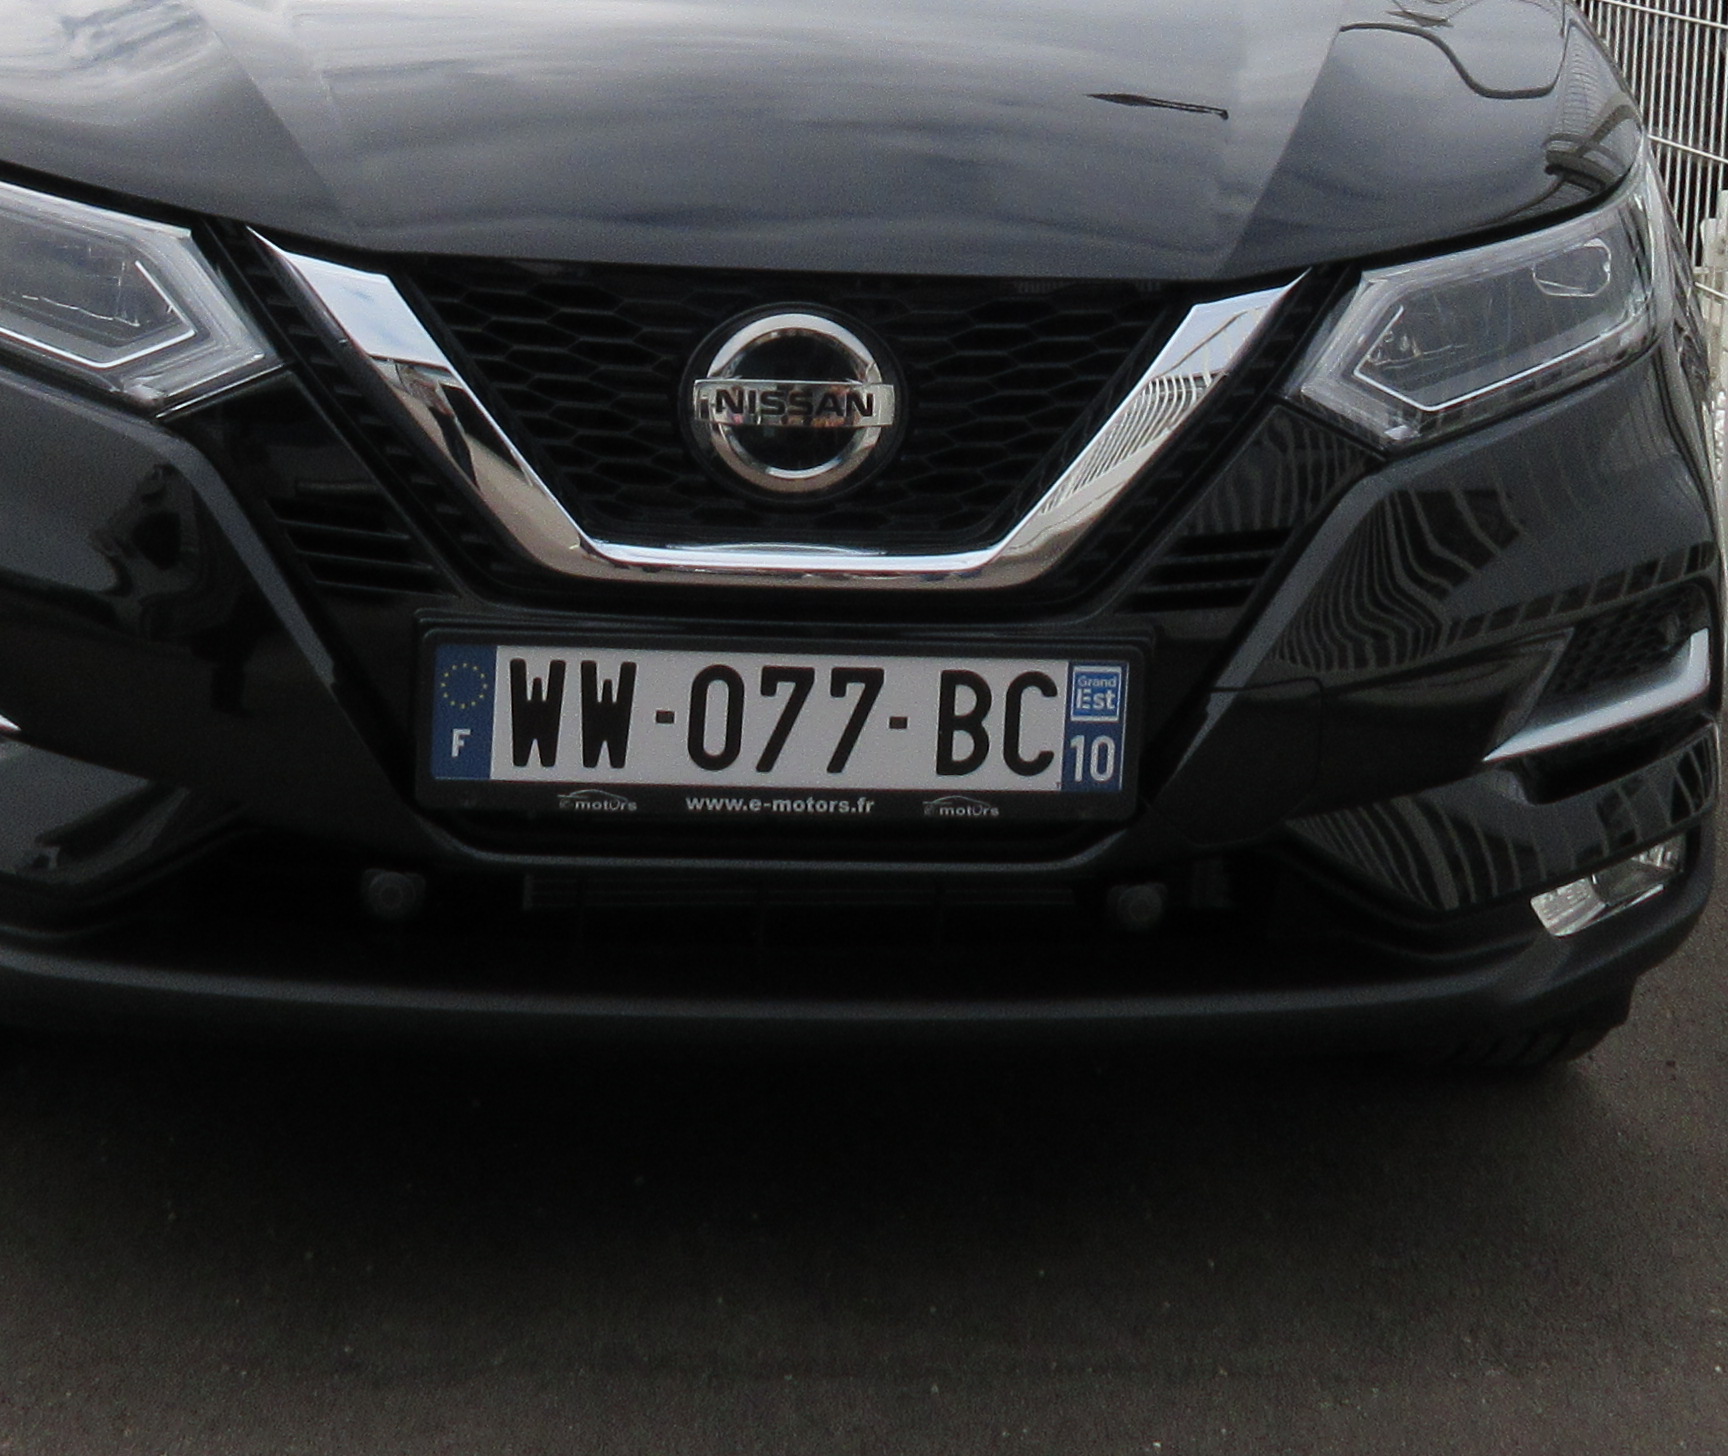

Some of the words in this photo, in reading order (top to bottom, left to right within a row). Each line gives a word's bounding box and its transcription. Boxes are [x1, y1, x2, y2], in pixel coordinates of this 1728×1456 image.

[715, 388, 874, 417] NISSAN
[1077, 675, 1117, 688] Grand
[1076, 688, 1116, 710] Est
[509, 658, 1059, 777] WW-077-BC
[451, 728, 471, 758] F
[1070, 735, 1115, 782] 10
[685, 796, 875, 814] www.e-motors.fr
